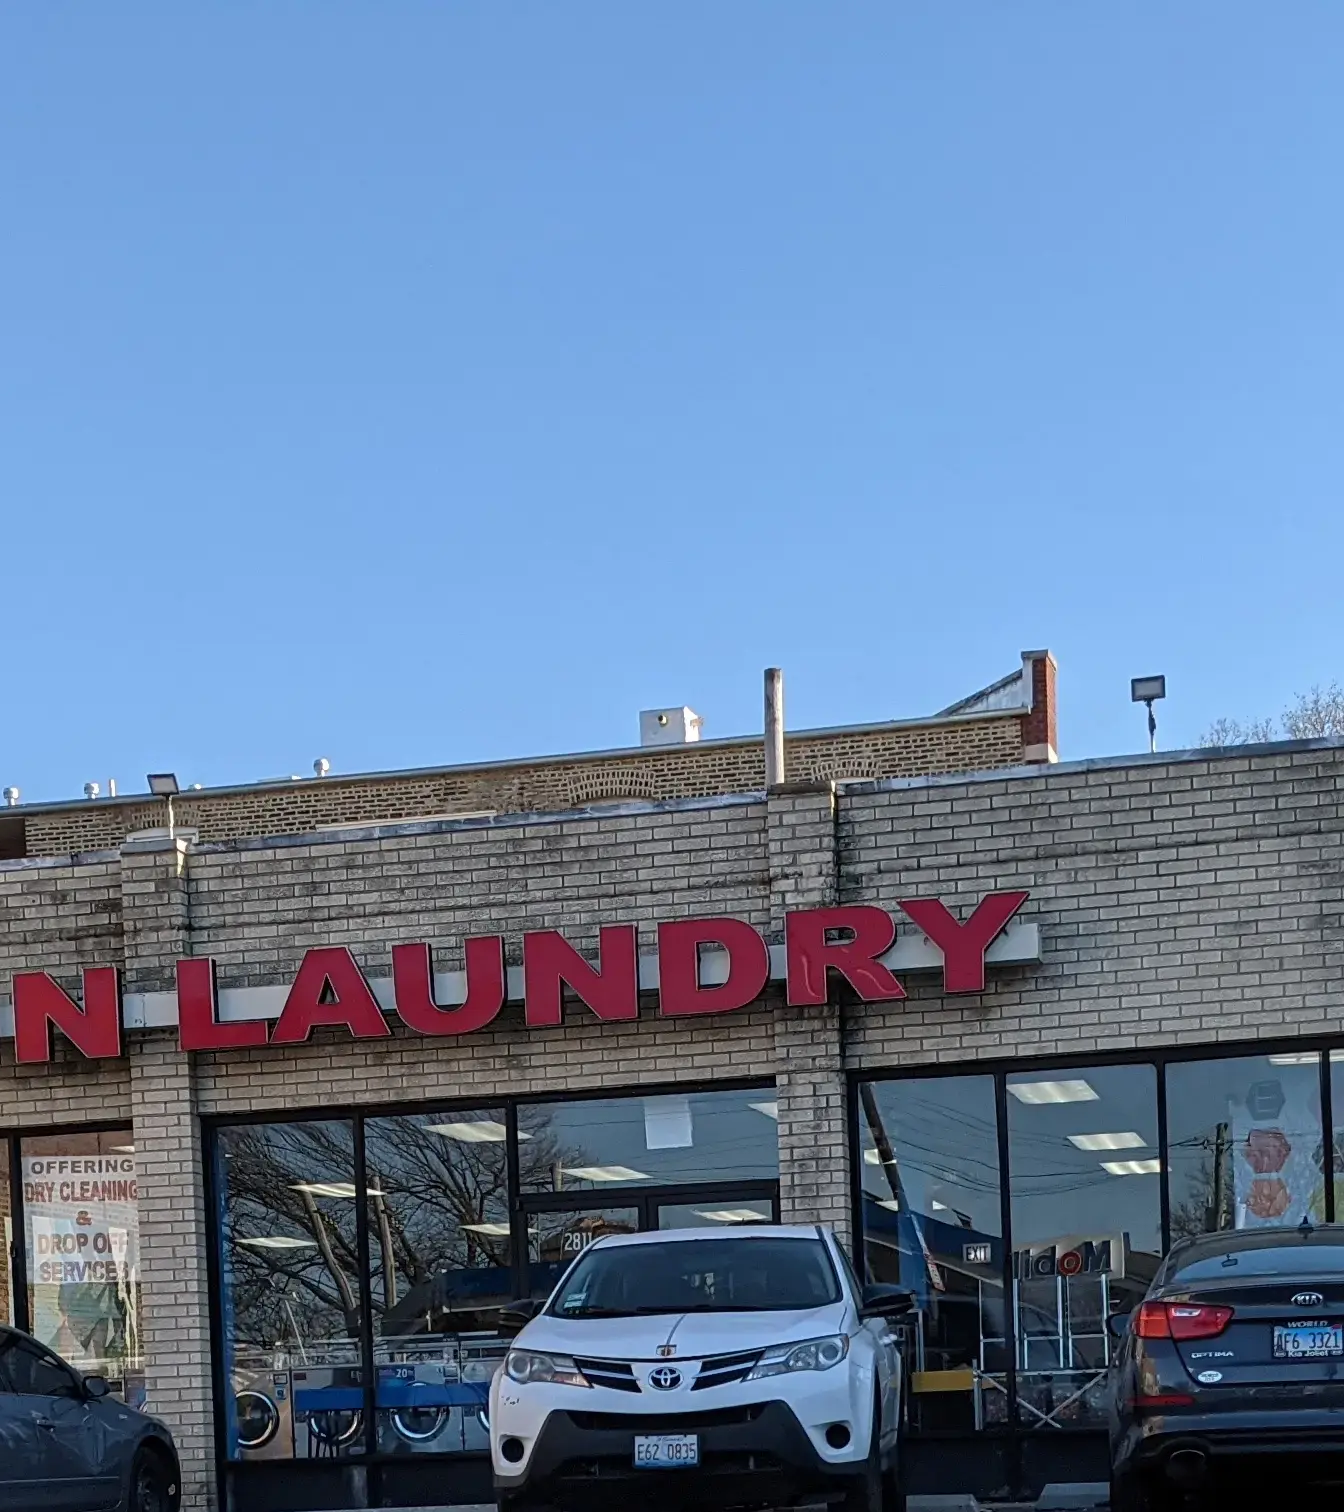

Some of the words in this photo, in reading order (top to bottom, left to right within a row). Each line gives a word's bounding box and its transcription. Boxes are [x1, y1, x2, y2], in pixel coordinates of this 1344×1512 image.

[175, 890, 1031, 1051] LAUNDRY
[30, 1159, 134, 1175] OFFERING
[24, 1180, 55, 1203] DRY
[59, 1179, 138, 1202] CLEANING
[76, 1210, 93, 1226] &
[37, 1232, 89, 1255] DROP
[93, 1231, 129, 1254] OFF
[966, 1245, 990, 1261] EXIT
[39, 1260, 129, 1282] SERVICES
[1297, 1294, 1318, 1305] KIA
[1308, 1331, 1340, 1349] 3321
[637, 1443, 659, 1461] E62
[667, 1442, 696, 1460] 0835
